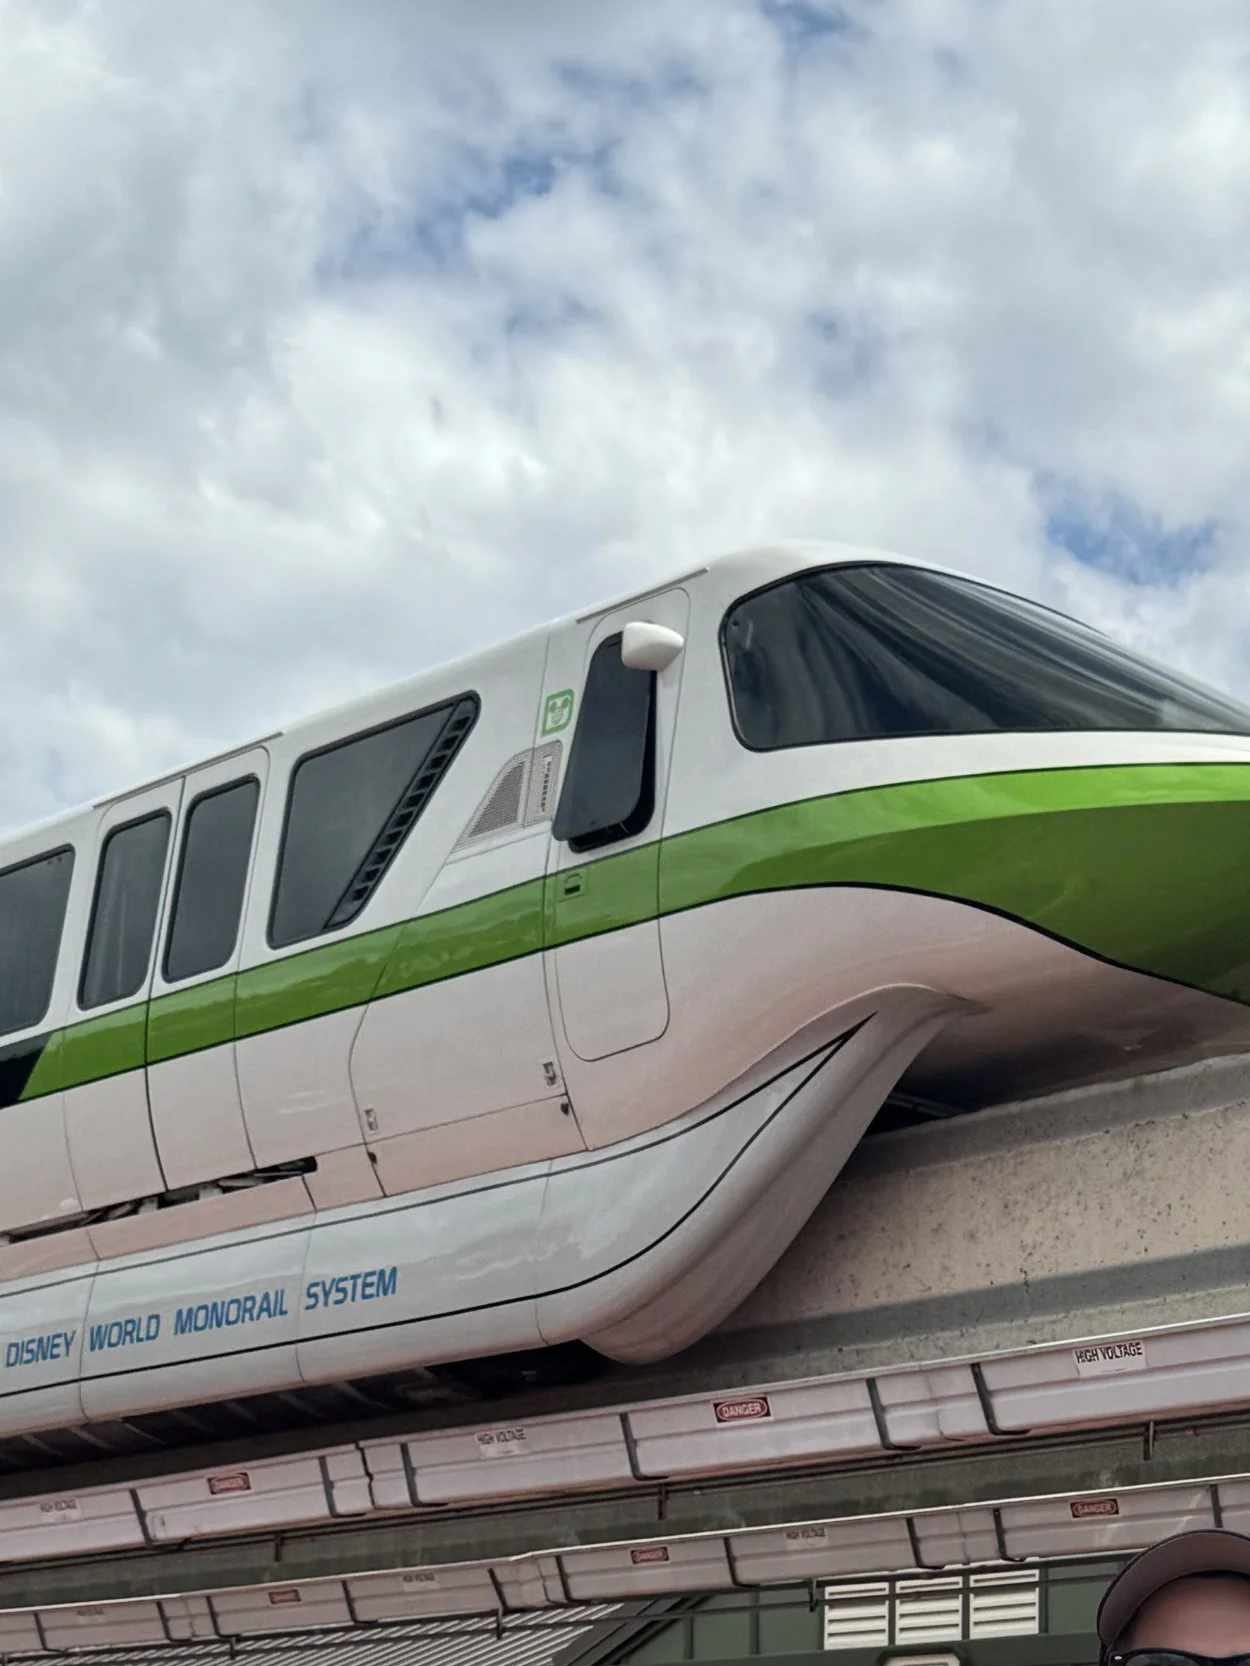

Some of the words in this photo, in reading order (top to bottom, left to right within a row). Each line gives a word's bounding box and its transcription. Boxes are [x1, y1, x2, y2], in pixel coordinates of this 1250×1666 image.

[5, 1330, 77, 1368] DISNEY
[89, 1314, 160, 1352] WORLD
[173, 1288, 288, 1336] MONORAIL
[304, 1266, 398, 1311] SYSTEM
[1075, 1348, 1100, 1364] HIGH
[1100, 1342, 1143, 1361] VOLTAGE
[722, 1402, 762, 1418] DANGER
